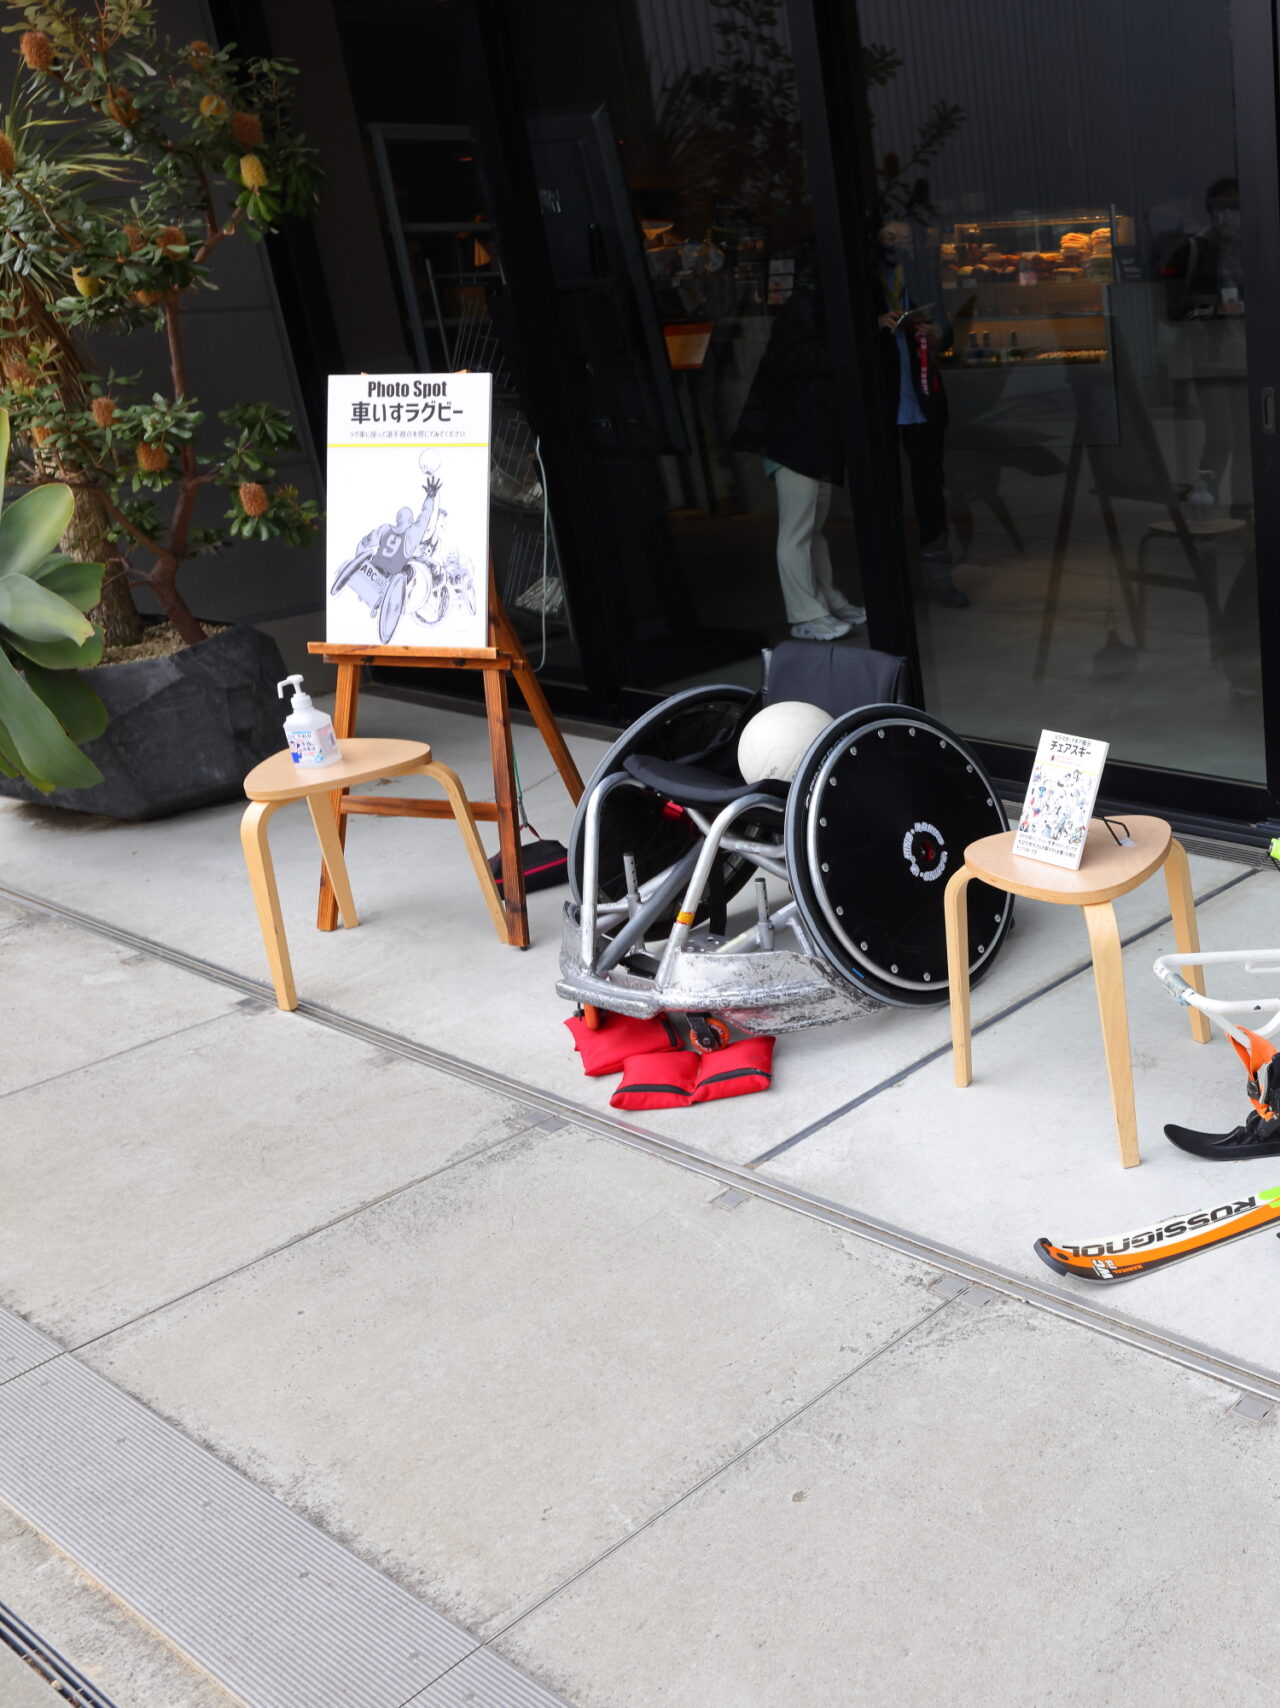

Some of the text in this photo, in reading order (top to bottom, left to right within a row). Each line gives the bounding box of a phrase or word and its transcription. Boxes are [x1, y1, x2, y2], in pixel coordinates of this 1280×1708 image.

[367, 379, 448, 399] Photo Spot
[351, 400, 464, 425] 車いすラグビー
[381, 534, 402, 558] 9
[1049, 740, 1092, 758] チェアスキー
[1062, 1196, 1256, 1258] ROSSIGNOL
